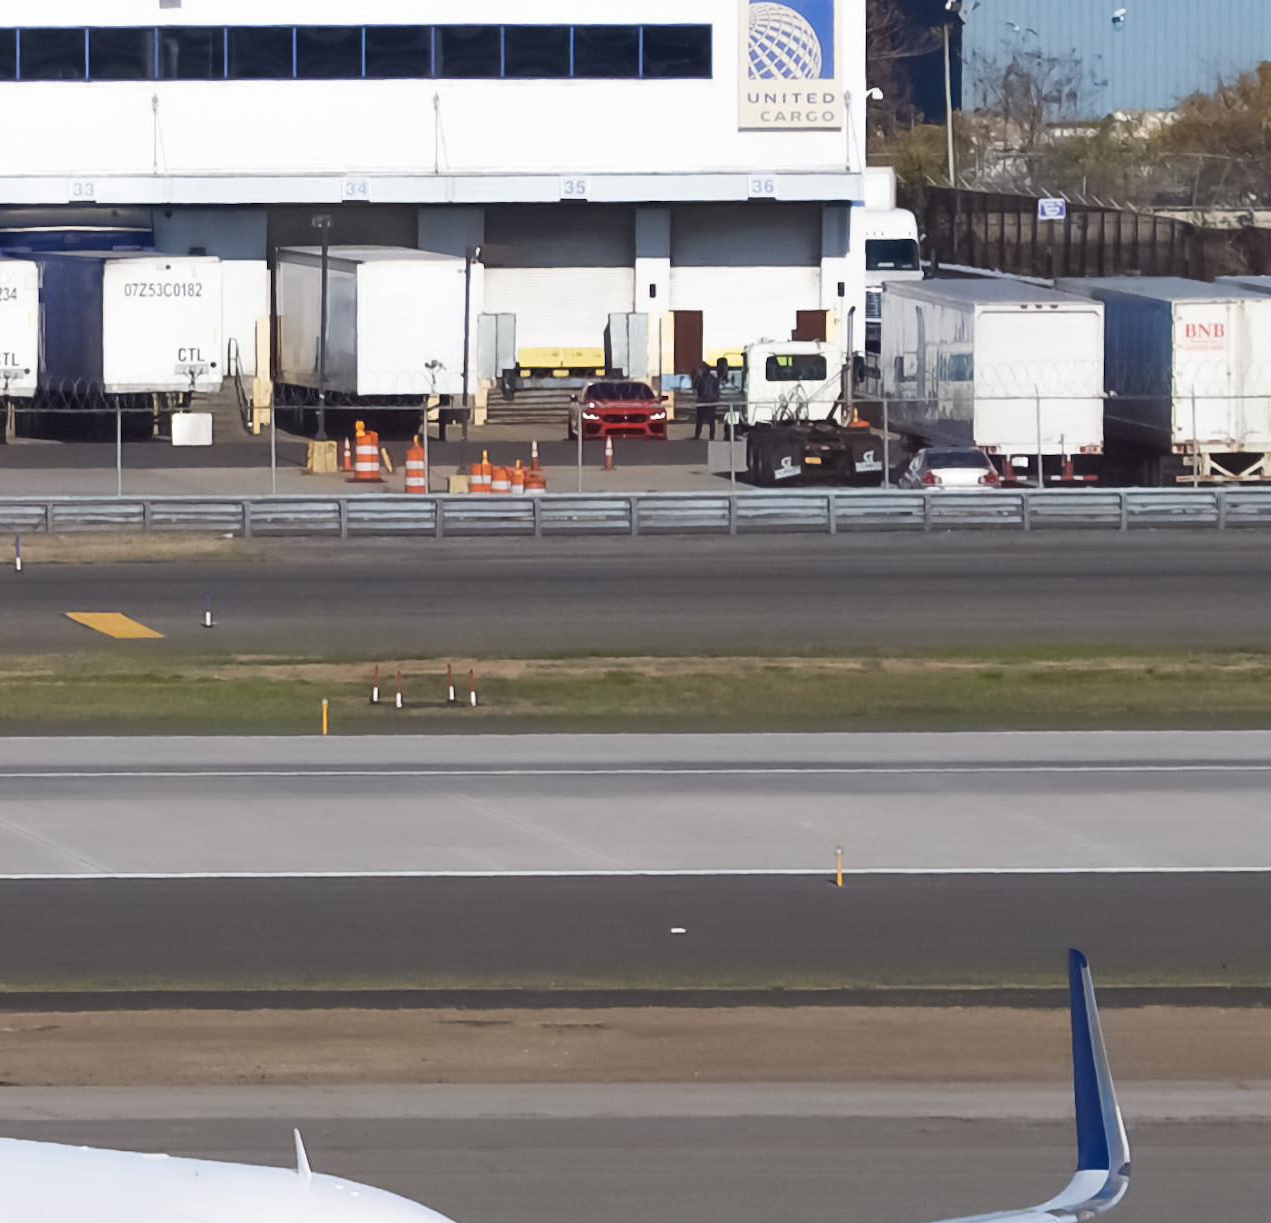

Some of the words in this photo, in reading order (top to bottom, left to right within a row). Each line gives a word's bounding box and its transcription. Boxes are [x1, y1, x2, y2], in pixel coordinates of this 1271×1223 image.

[747, 93, 836, 104] UNITED
[760, 111, 836, 122] CARGO
[72, 182, 94, 196] 33
[346, 181, 367, 195] 34
[564, 180, 586, 194] 35
[752, 179, 774, 194] 36
[124, 282, 202, 298] 07Z53C0182
[1185, 323, 1225, 338] BNB
[178, 348, 205, 362] CTL
